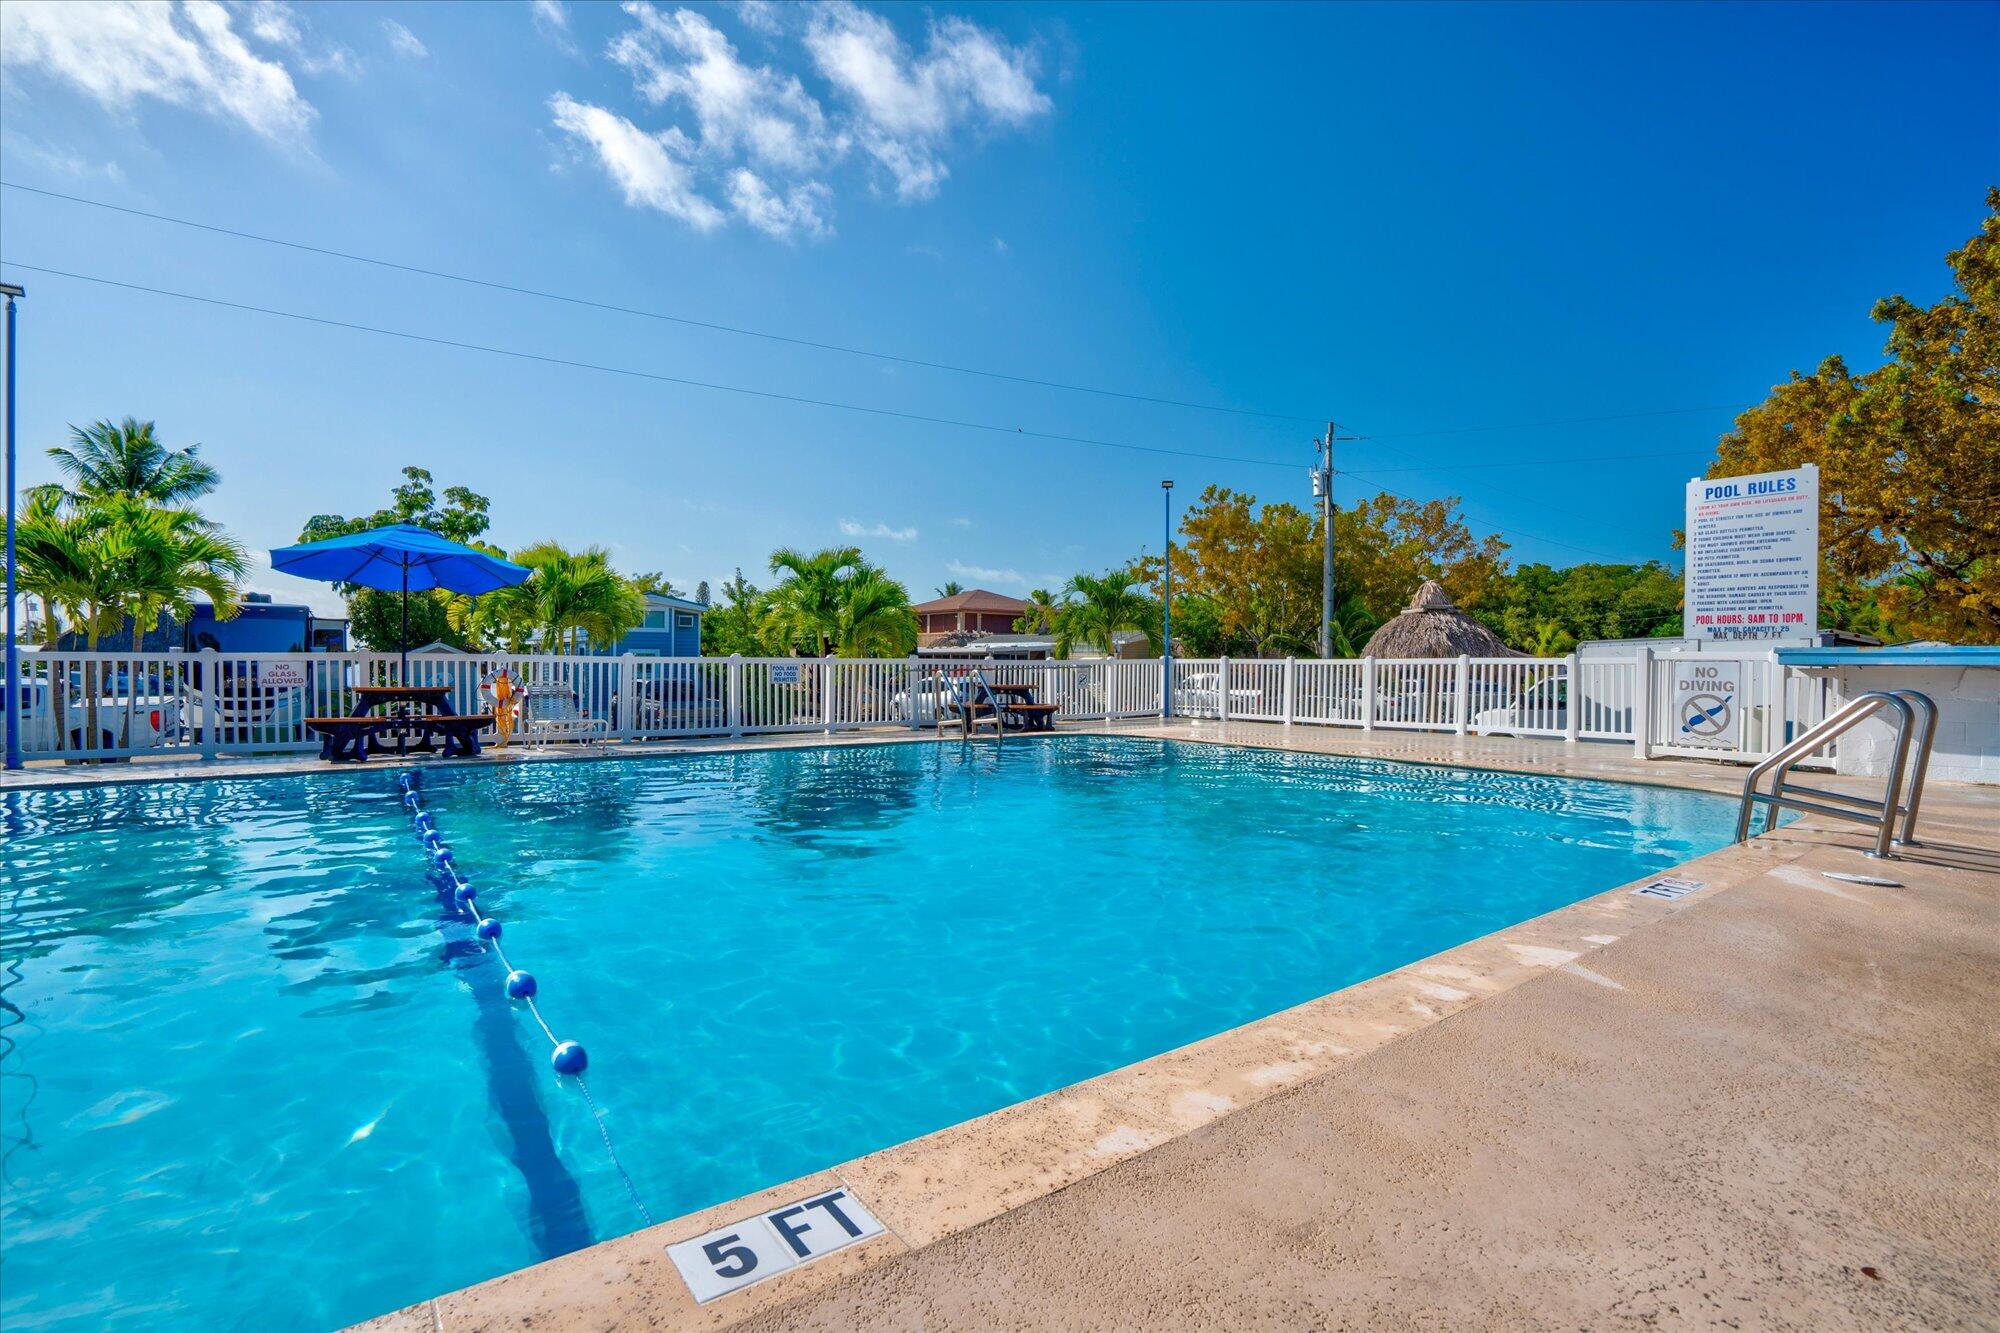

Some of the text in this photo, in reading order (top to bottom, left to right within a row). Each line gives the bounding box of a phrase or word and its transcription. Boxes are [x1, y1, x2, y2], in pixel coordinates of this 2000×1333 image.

[1706, 478, 1796, 500] POOL RULES
[1696, 613, 1804, 624] POOL HOURS: 9AM TO 10PM
[1695, 667, 1718, 678] NO
[1680, 680, 1734, 692] DIVING
[702, 1191, 863, 1278] 5 FT
